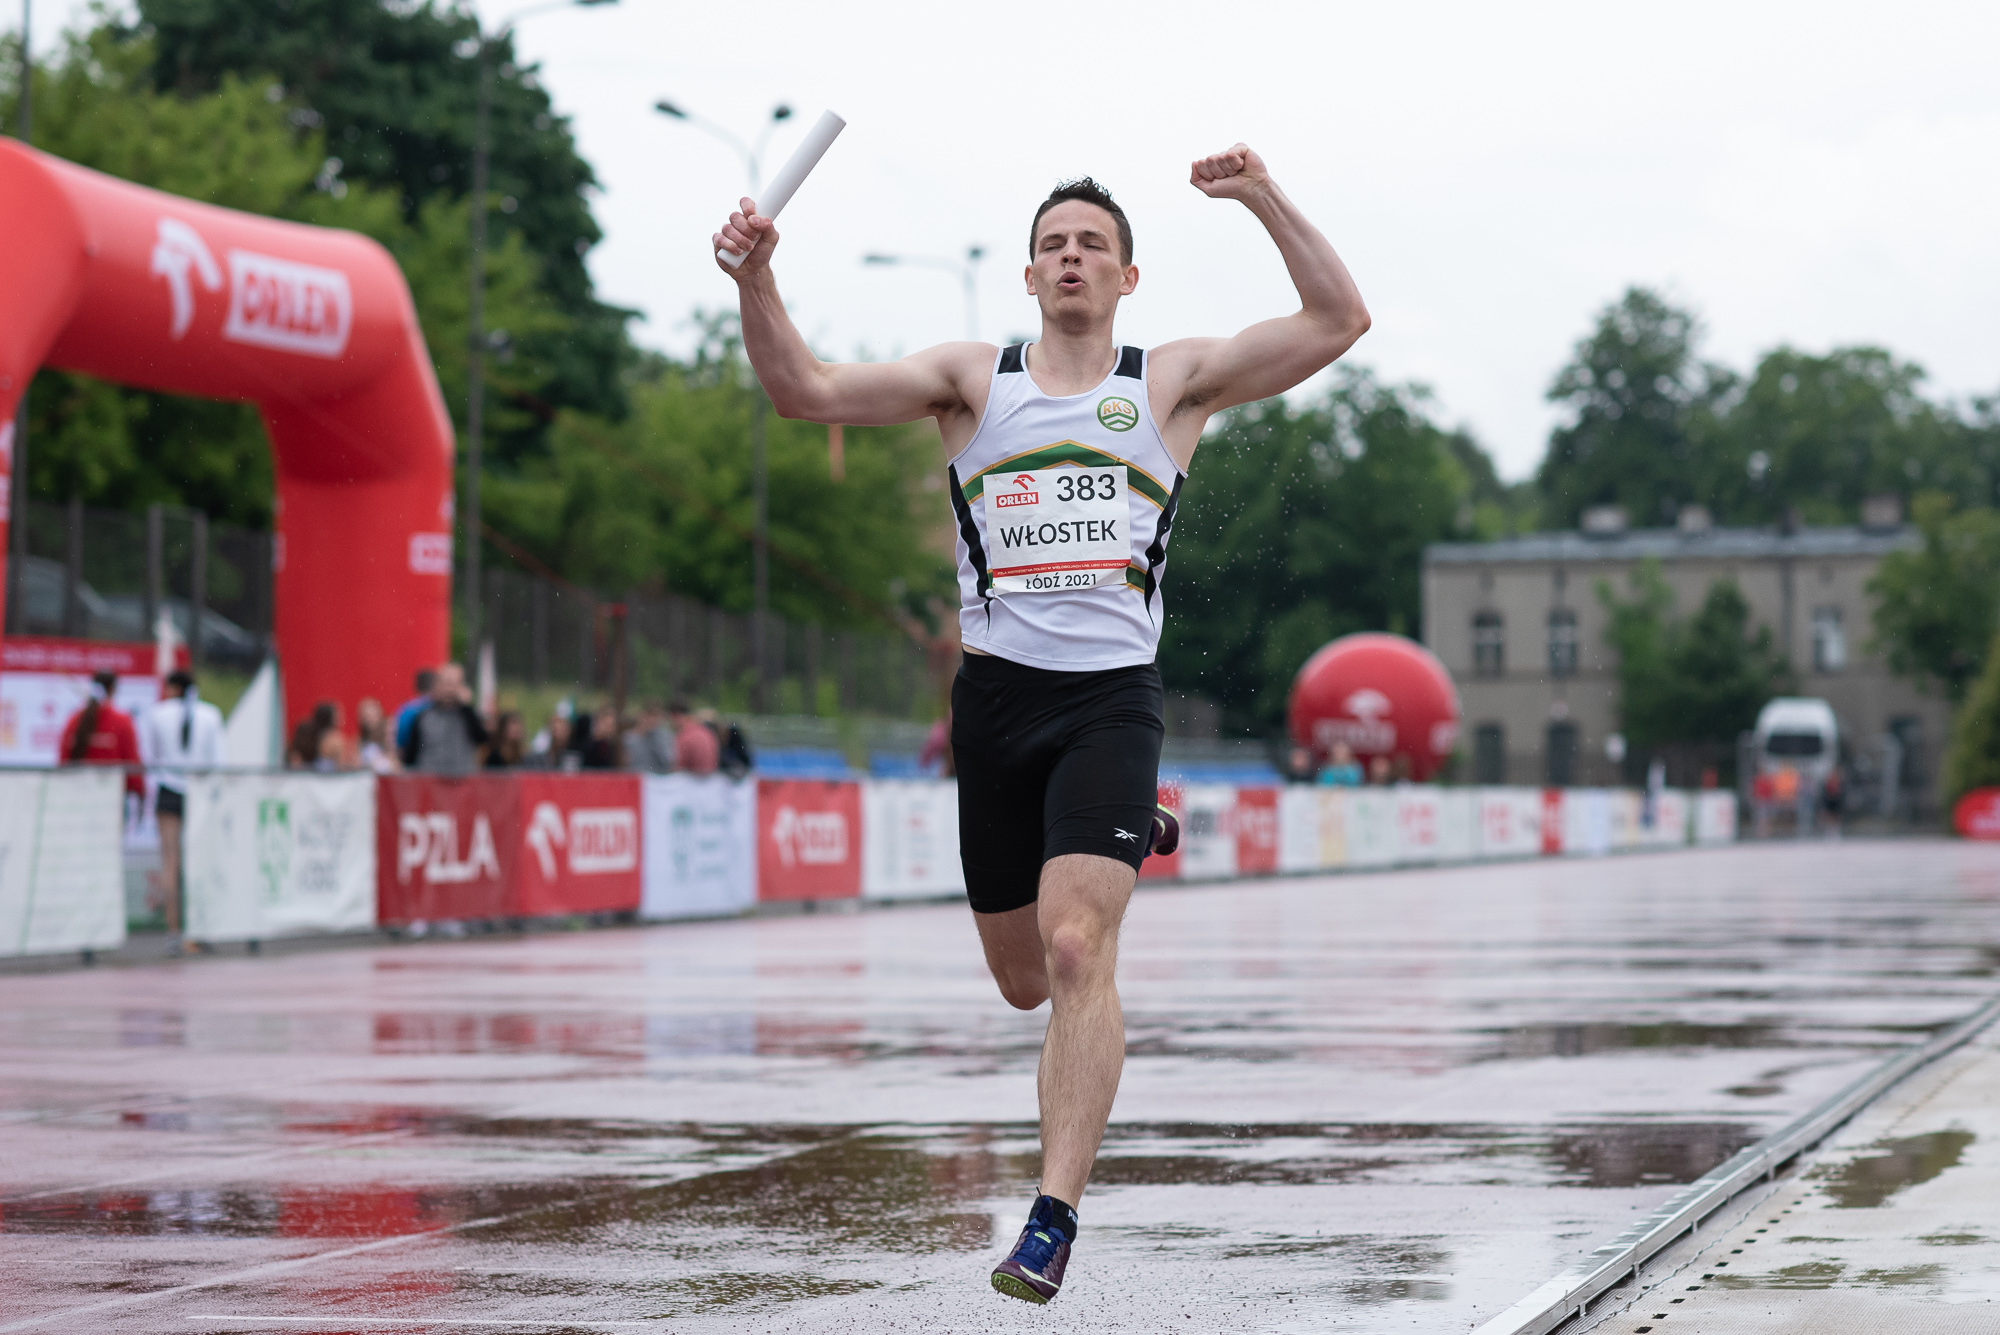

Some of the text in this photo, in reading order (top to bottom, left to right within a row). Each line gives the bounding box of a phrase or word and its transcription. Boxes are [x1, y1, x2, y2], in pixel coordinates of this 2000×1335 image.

[1103, 401, 1132, 415] RKS
[1056, 473, 1117, 502] 383
[998, 493, 1037, 507] ORLEN
[1000, 519, 1118, 549] WŁOSTEK
[1025, 572, 1097, 590] ŁÓDŹ 2021
[397, 812, 500, 885] PZLA
